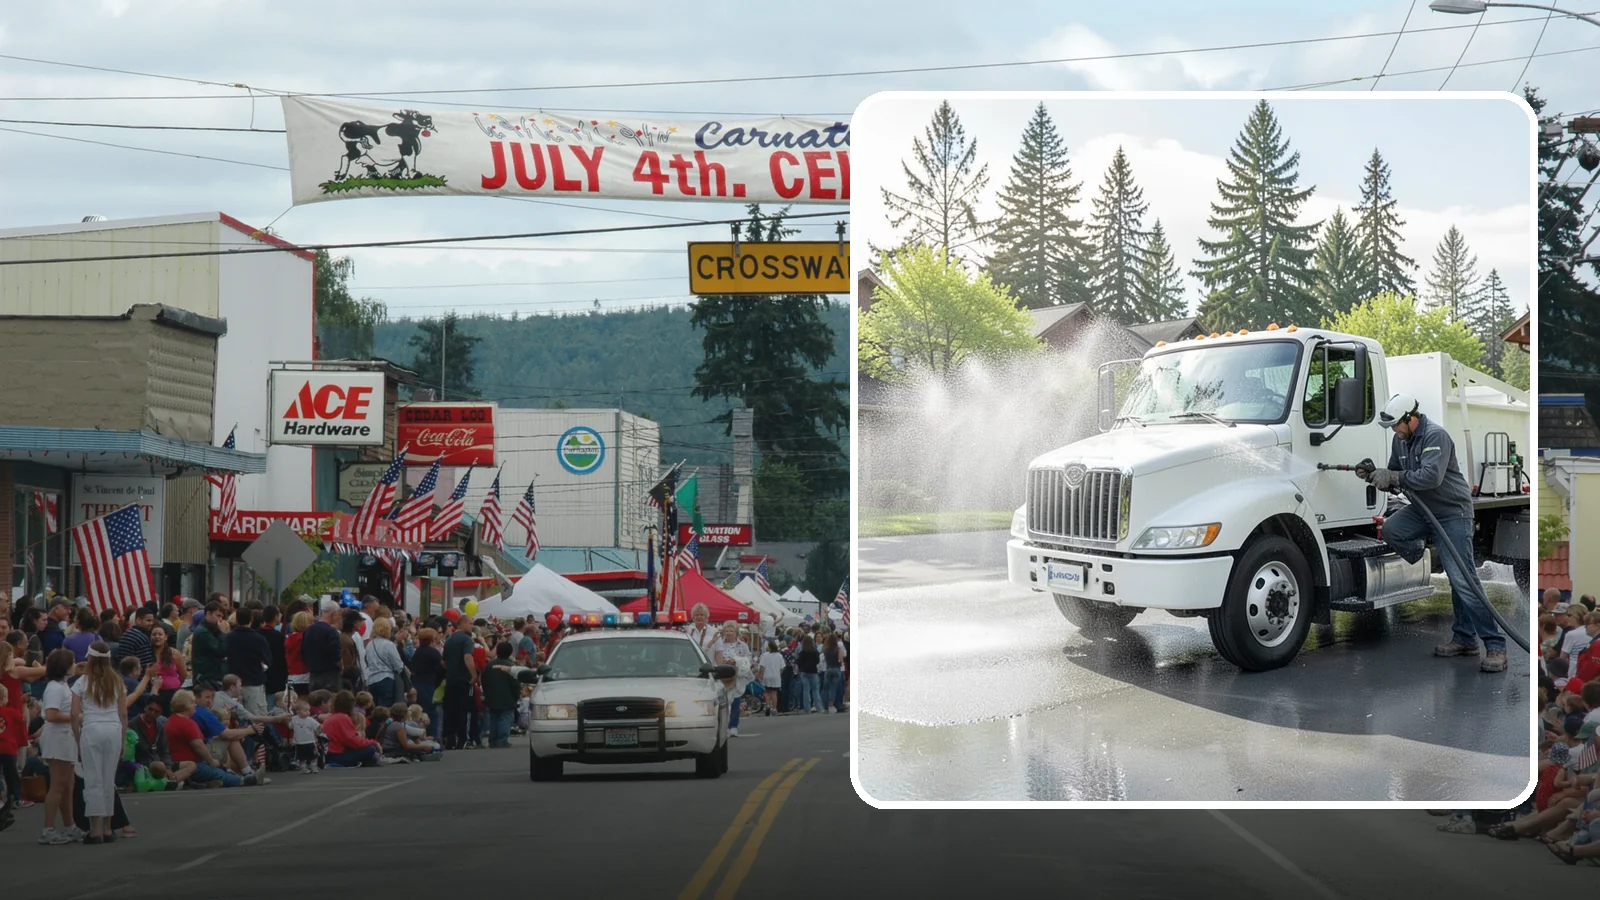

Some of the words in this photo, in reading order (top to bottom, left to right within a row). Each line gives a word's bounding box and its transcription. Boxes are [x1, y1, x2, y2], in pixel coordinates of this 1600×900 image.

[695, 122, 850, 149] Carnat
[481, 141, 604, 192] JULY
[632, 151, 746, 197] 4th.
[697, 254, 850, 280] CROSSWA
[283, 380, 373, 420] ACE
[405, 409, 452, 422] CEDAR
[283, 421, 370, 436] Hardware
[416, 428, 477, 446] Coca-Cola
[353, 467, 386, 480] Simpl
[95, 485, 124, 495] Vincent
[126, 485, 136, 495] de
[137, 485, 155, 495] Paul
[688, 526, 741, 535] CRNATION
[699, 535, 730, 543] GLASS
